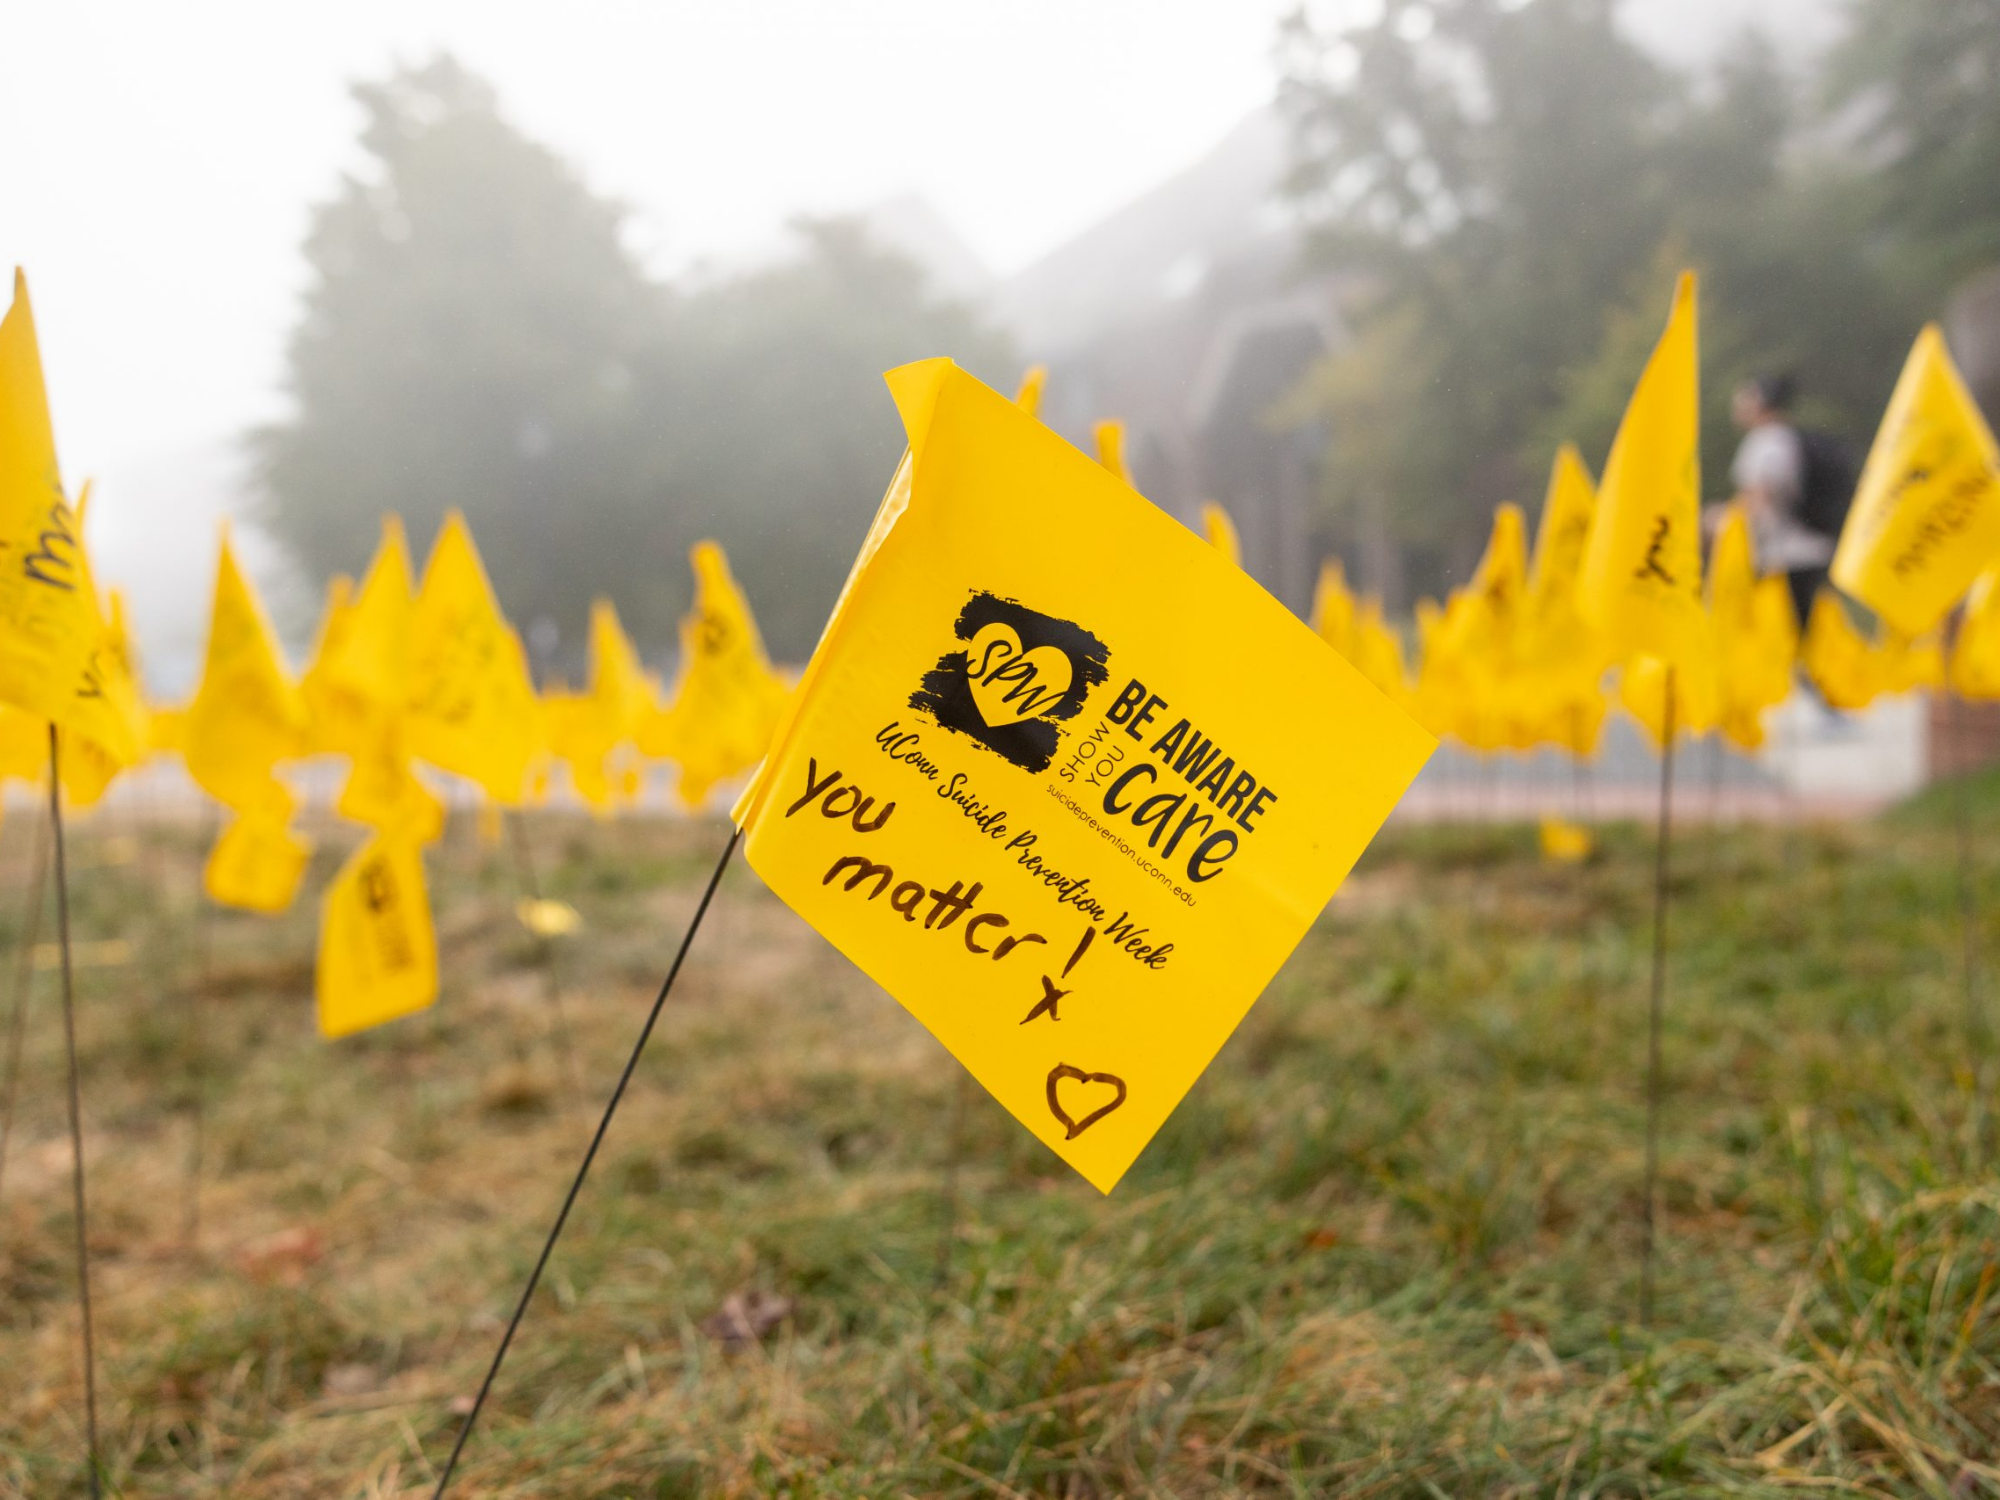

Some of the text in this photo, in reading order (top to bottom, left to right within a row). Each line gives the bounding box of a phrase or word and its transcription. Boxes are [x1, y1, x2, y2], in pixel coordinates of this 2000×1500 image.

[966, 639, 1070, 716] SPW
[1059, 720, 1111, 784] SHOW
[1084, 744, 1126, 788] YOU
[1104, 677, 1279, 834] BE AWARE
[875, 721, 1175, 971] UConn Suicide Prevention Week
[1046, 783, 1197, 908] suicideprevention.uconn.edu
